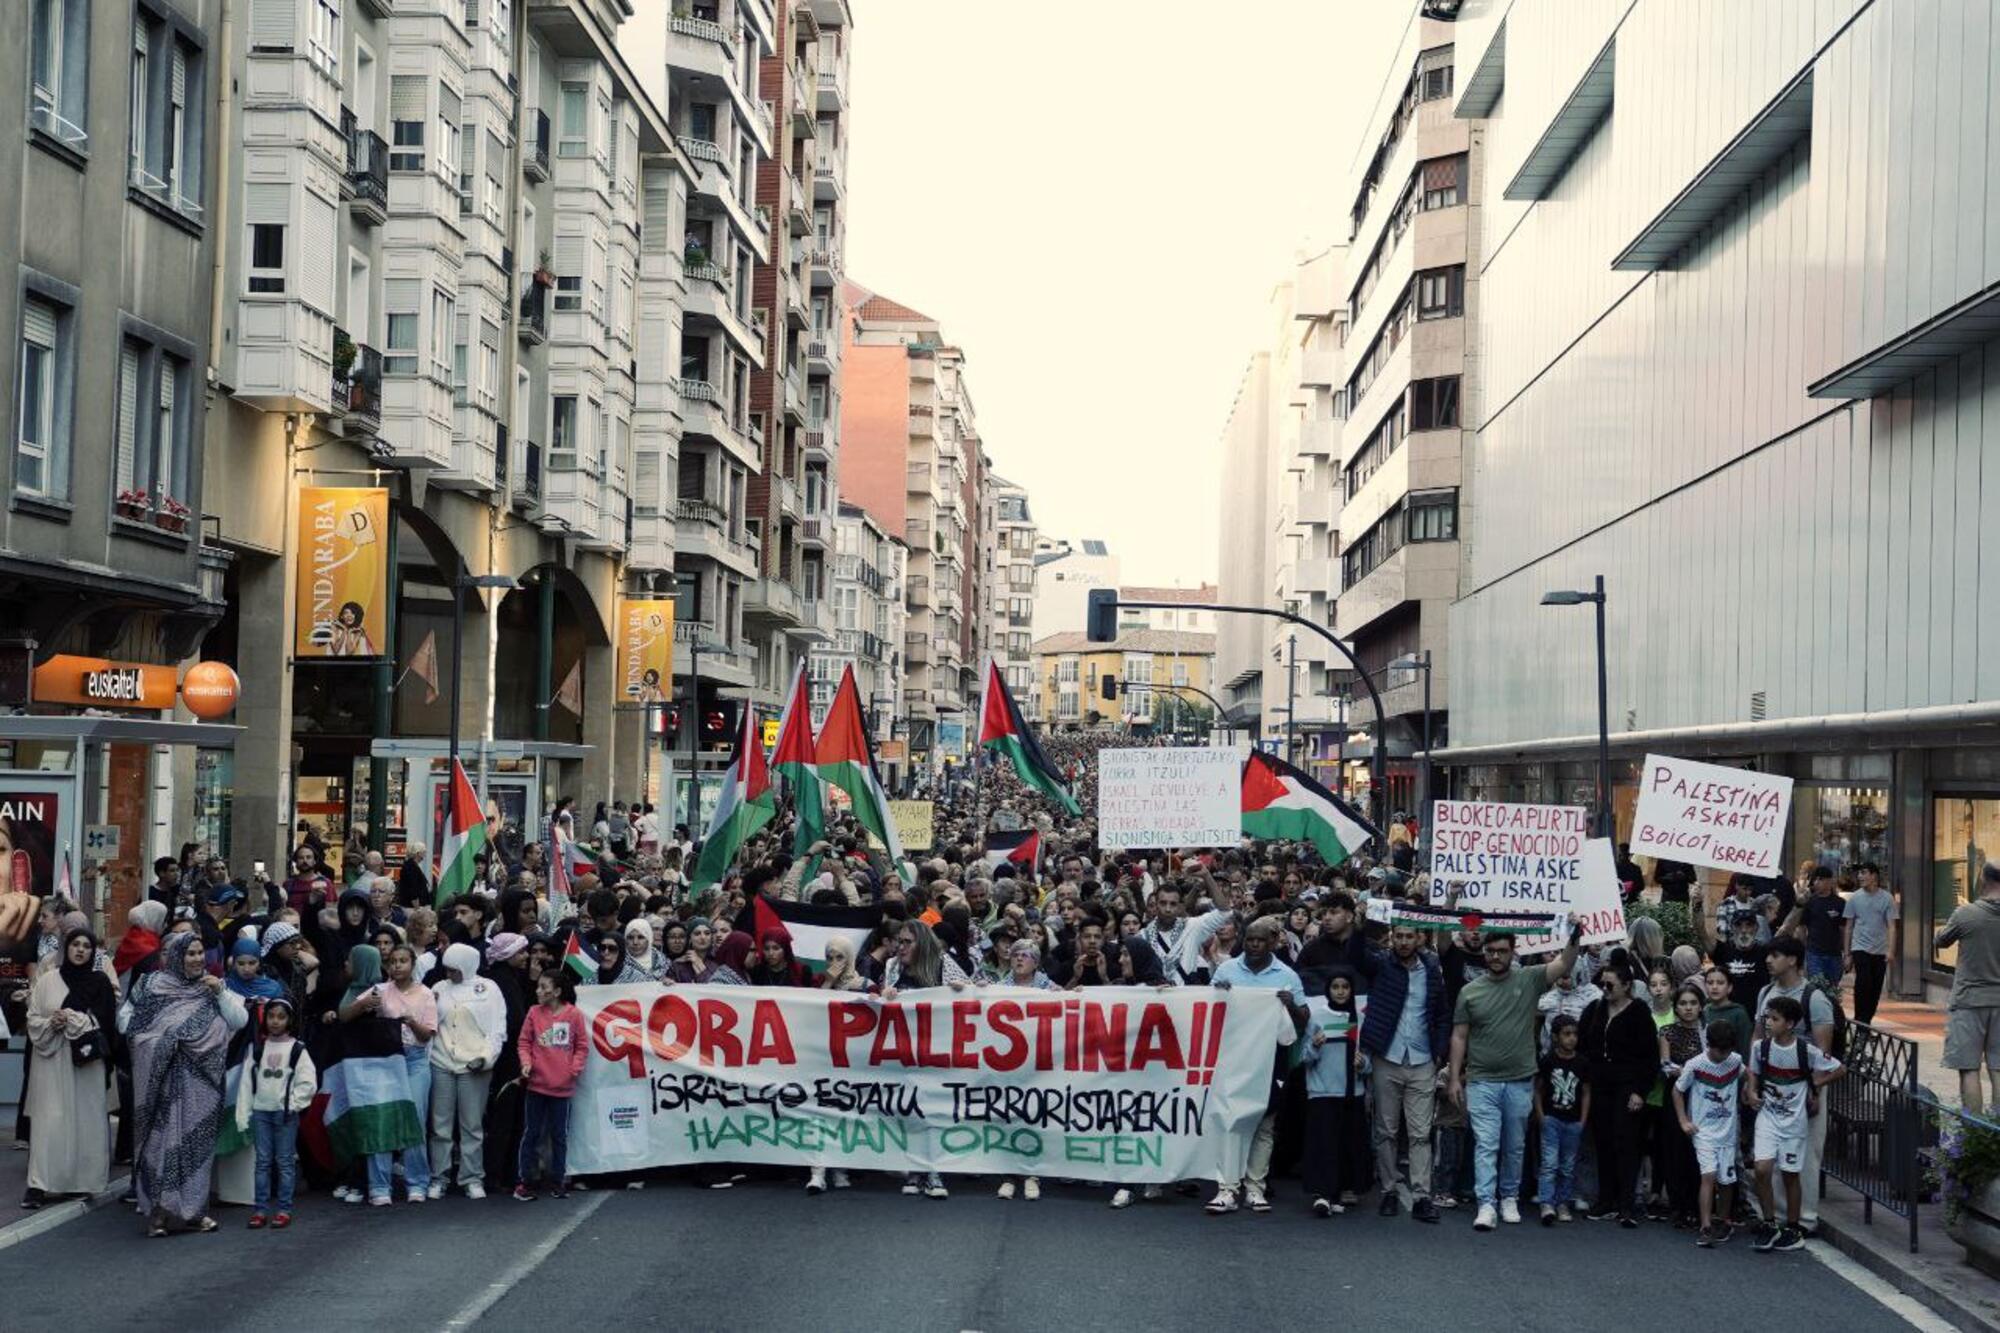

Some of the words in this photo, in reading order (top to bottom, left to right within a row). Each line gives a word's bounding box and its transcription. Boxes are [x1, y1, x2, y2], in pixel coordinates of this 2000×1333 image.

[88, 669, 136, 699] euskaltel
[1681, 805, 1775, 838] ASKATU!
[1435, 853, 1527, 877] PALESTINA
[1536, 859, 1580, 881] ASKE
[1502, 881, 1571, 903] ISRAEL
[592, 994, 796, 1078] GORA
[813, 1078, 925, 1118] ESTATU
[685, 1113, 908, 1154] HARREMAN
[940, 1125, 1042, 1157] ORO
[1064, 1135, 1162, 1166] ETEN
